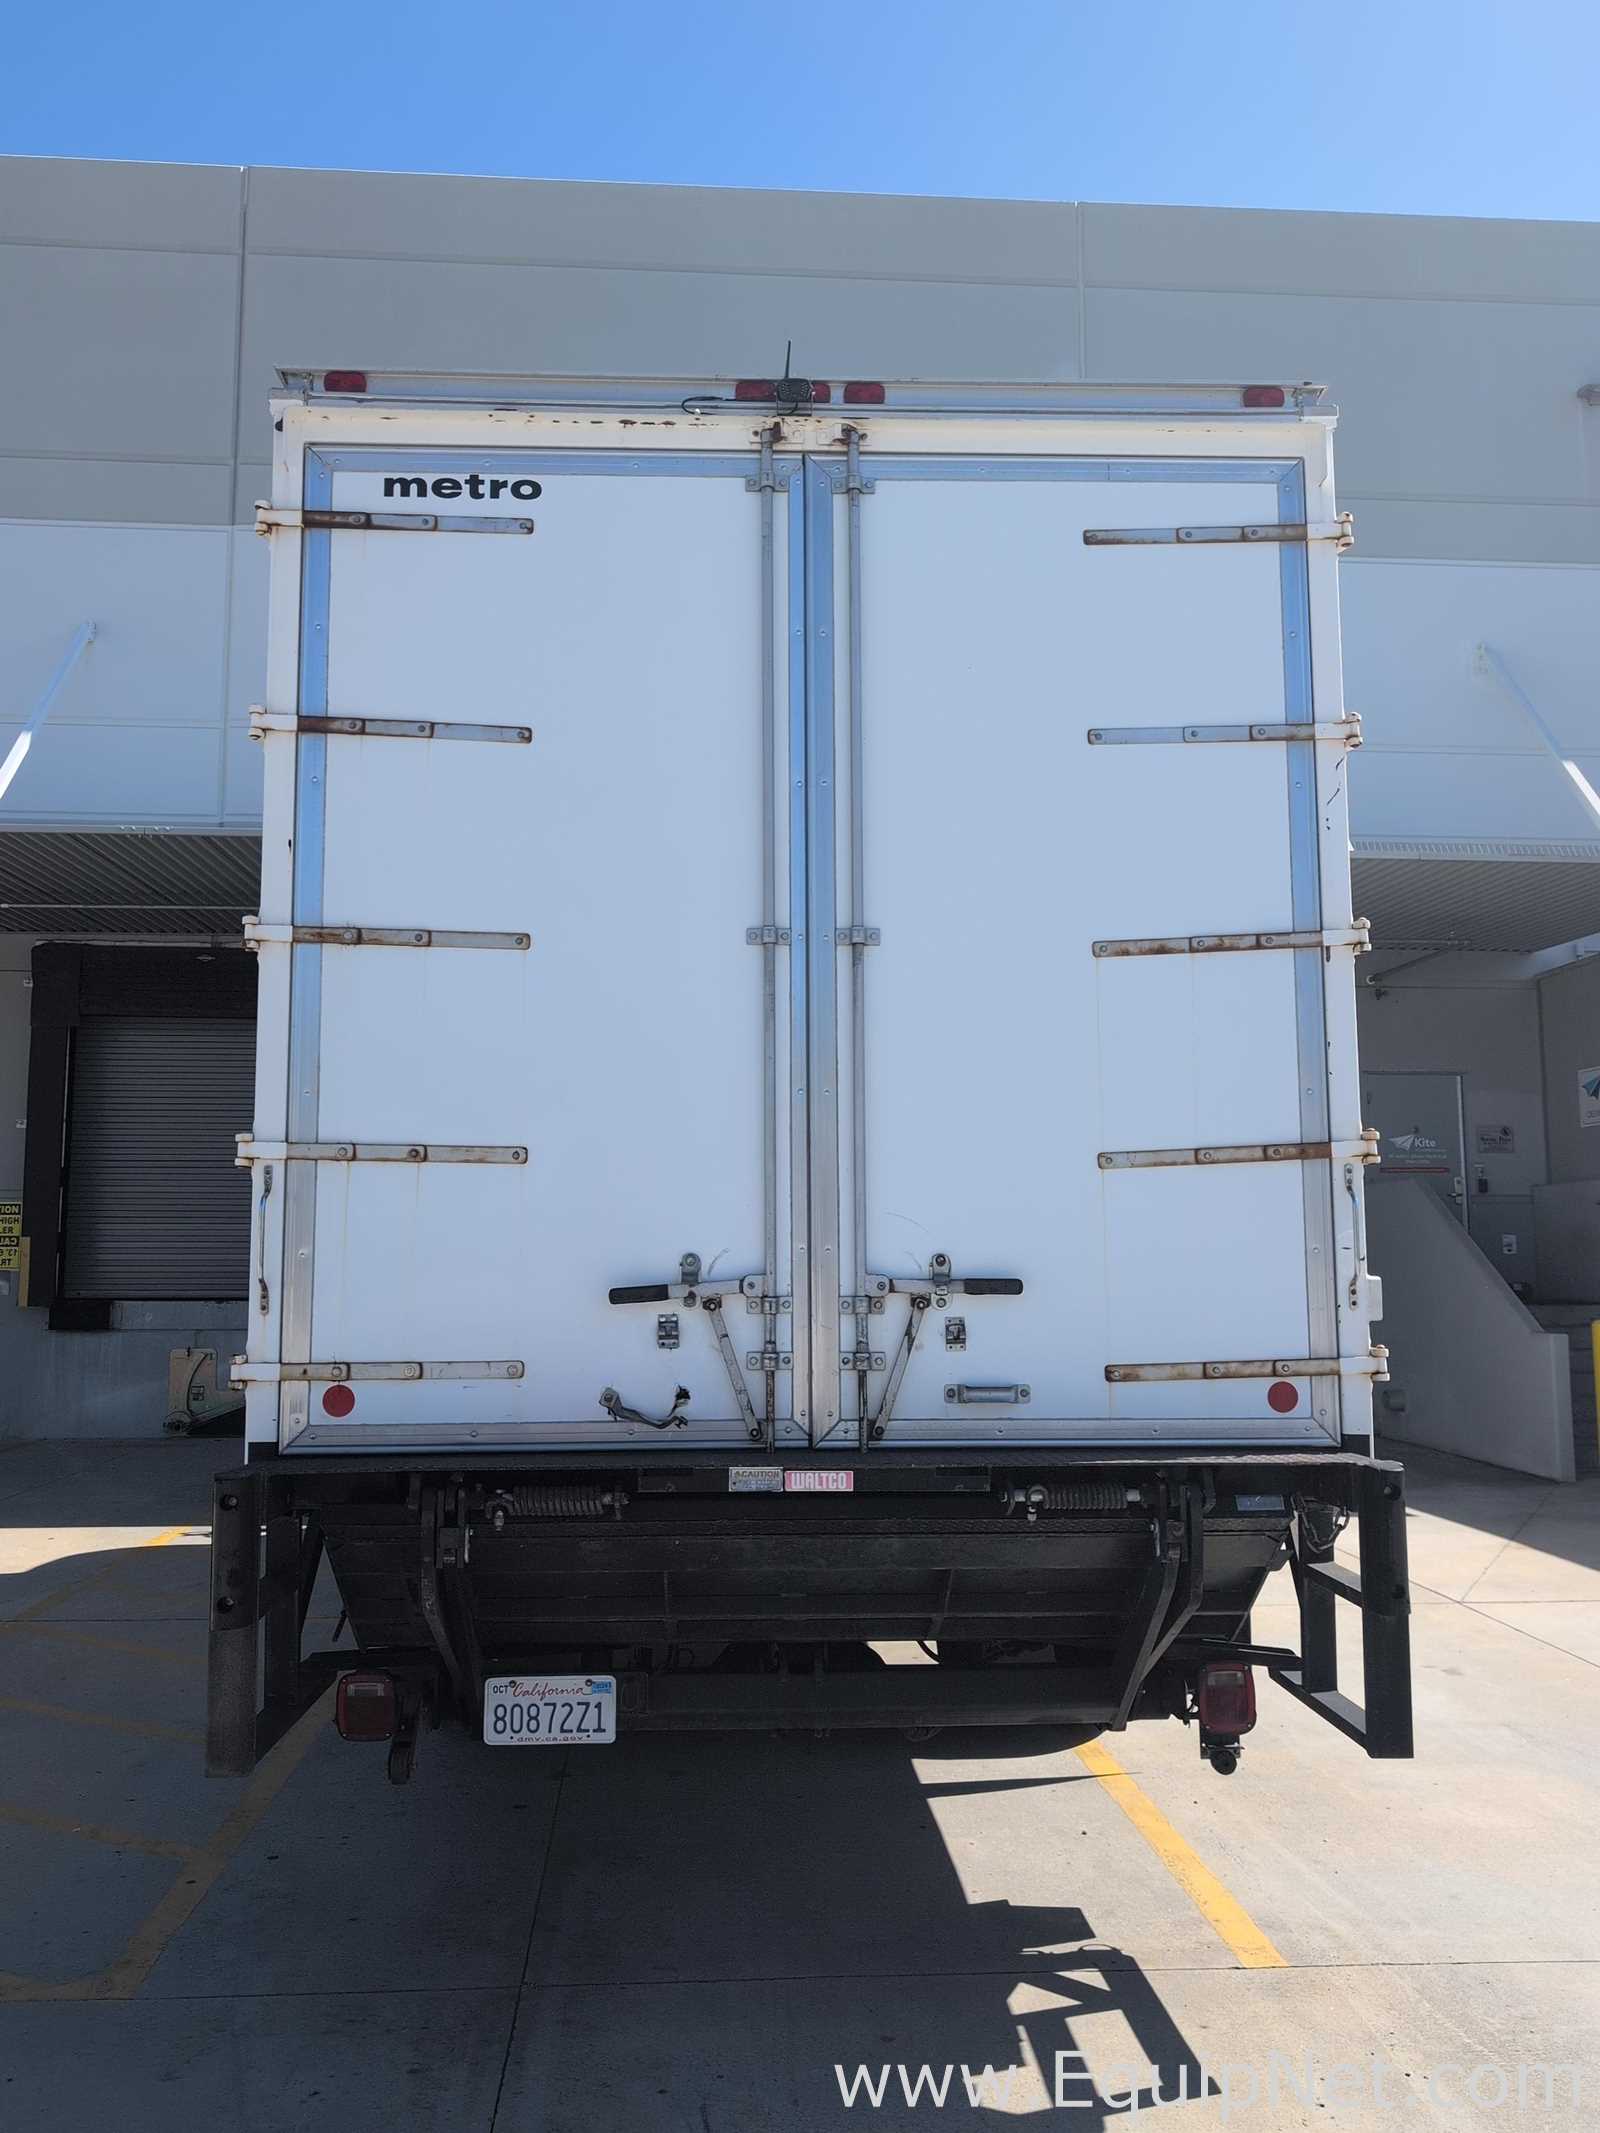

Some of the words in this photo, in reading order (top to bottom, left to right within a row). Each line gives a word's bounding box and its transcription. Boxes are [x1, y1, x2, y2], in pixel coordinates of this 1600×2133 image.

[384, 474, 542, 500] metro
[1414, 1136, 1436, 1147] Kite
[743, 1470, 779, 1479] CAUTION
[791, 1472, 847, 1489] WALTCO
[492, 1685, 509, 1694] OCT
[512, 1681, 586, 1700] California
[493, 1701, 606, 1734] 80872Z1
